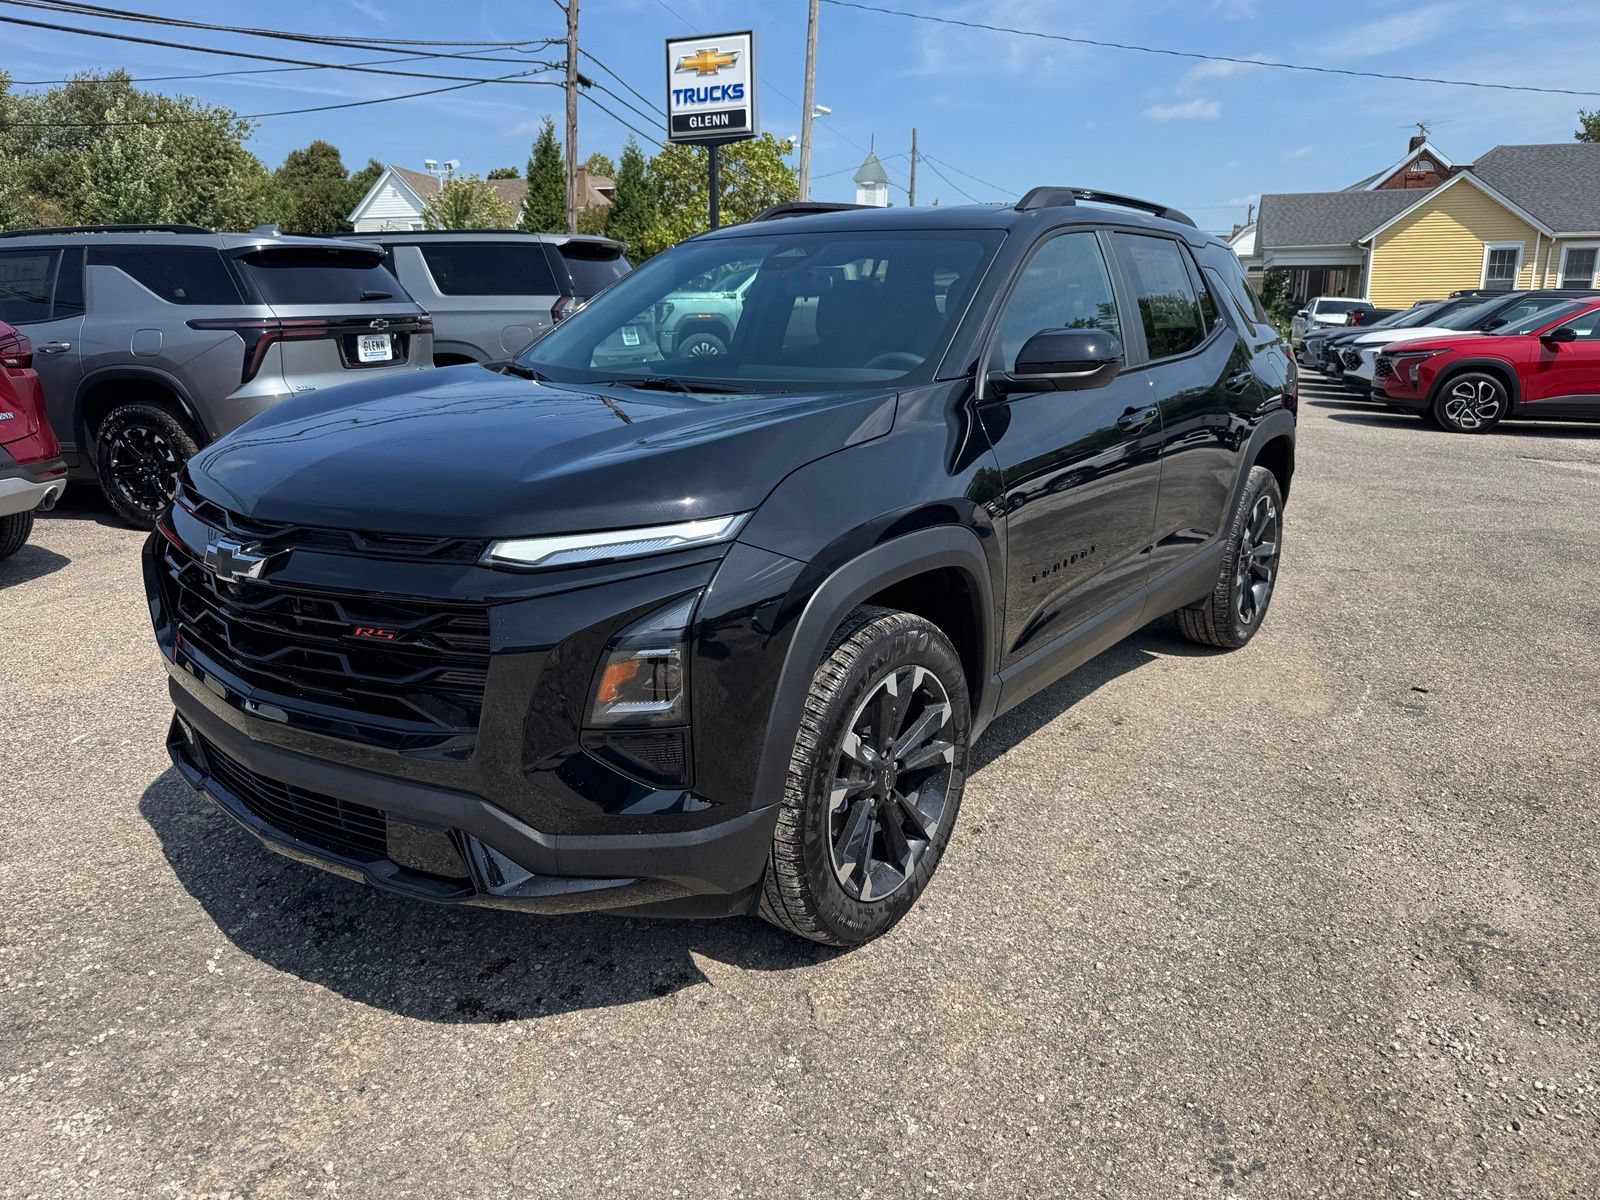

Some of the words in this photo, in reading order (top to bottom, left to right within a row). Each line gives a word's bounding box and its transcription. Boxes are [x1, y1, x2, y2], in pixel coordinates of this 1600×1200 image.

[672, 83, 744, 105] TRUCKS
[689, 114, 729, 127] GLENN
[363, 340, 386, 351] GLENN
[354, 626, 396, 641] RS
